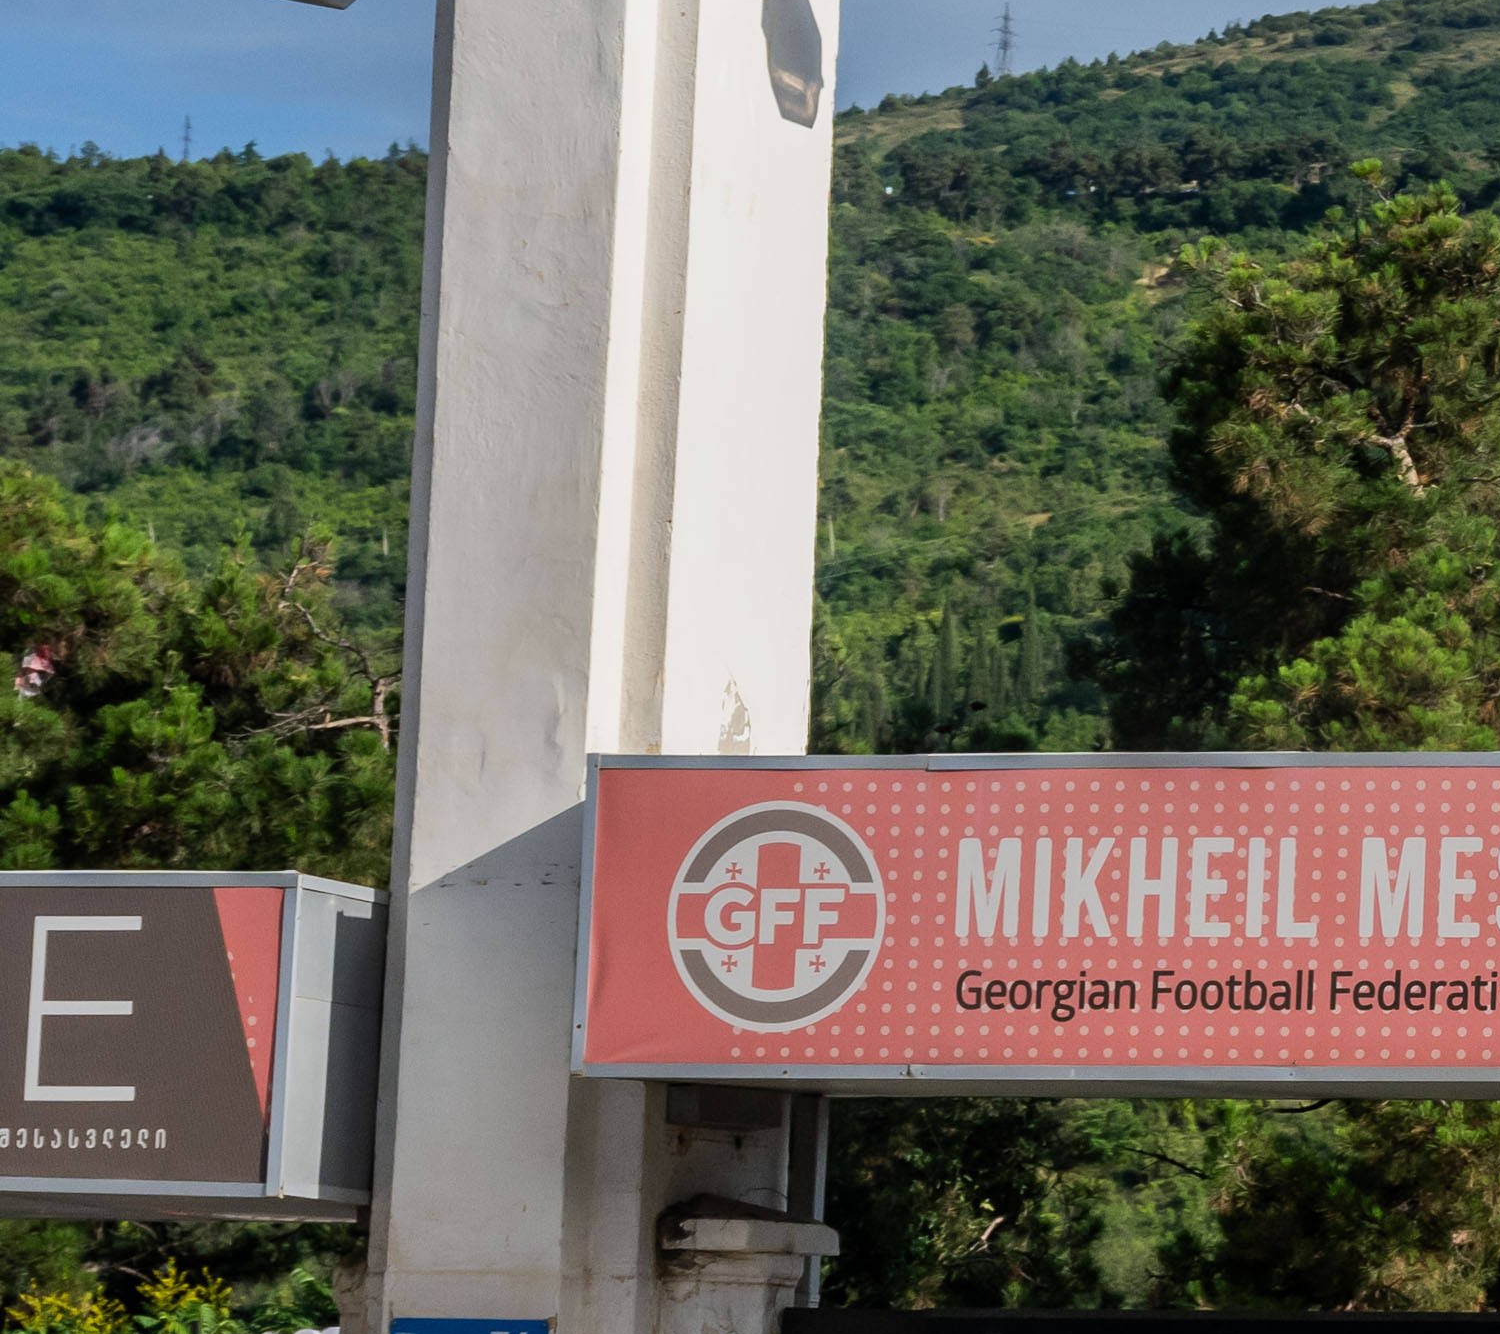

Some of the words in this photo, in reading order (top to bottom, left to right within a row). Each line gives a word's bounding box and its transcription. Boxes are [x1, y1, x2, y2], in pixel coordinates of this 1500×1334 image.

[702, 885, 847, 949] GFF
[953, 834, 1319, 941] MIKHEIL
[22, 914, 144, 1103] E
[954, 968, 1137, 1024] Georgian
[1150, 968, 1316, 1012] Football
